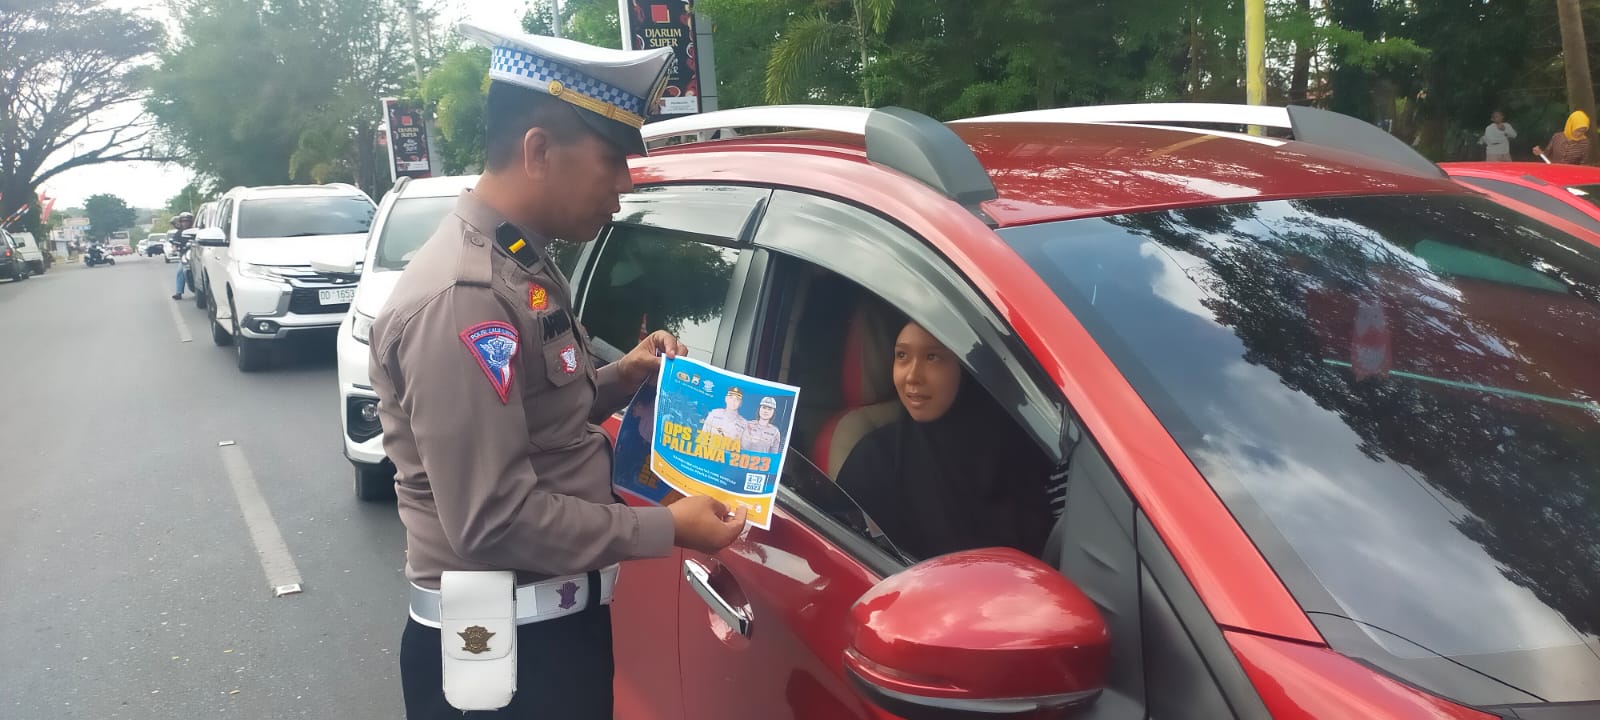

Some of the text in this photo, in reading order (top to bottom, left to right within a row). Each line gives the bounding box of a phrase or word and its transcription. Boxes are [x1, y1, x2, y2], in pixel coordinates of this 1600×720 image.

[645, 28, 682, 38] DJARUM
[650, 38, 678, 47] SUPER
[320, 290, 331, 300] DD
[664, 420, 692, 441] OPS
[662, 434, 725, 462] PALLAWA
[729, 452, 771, 472] 2023
